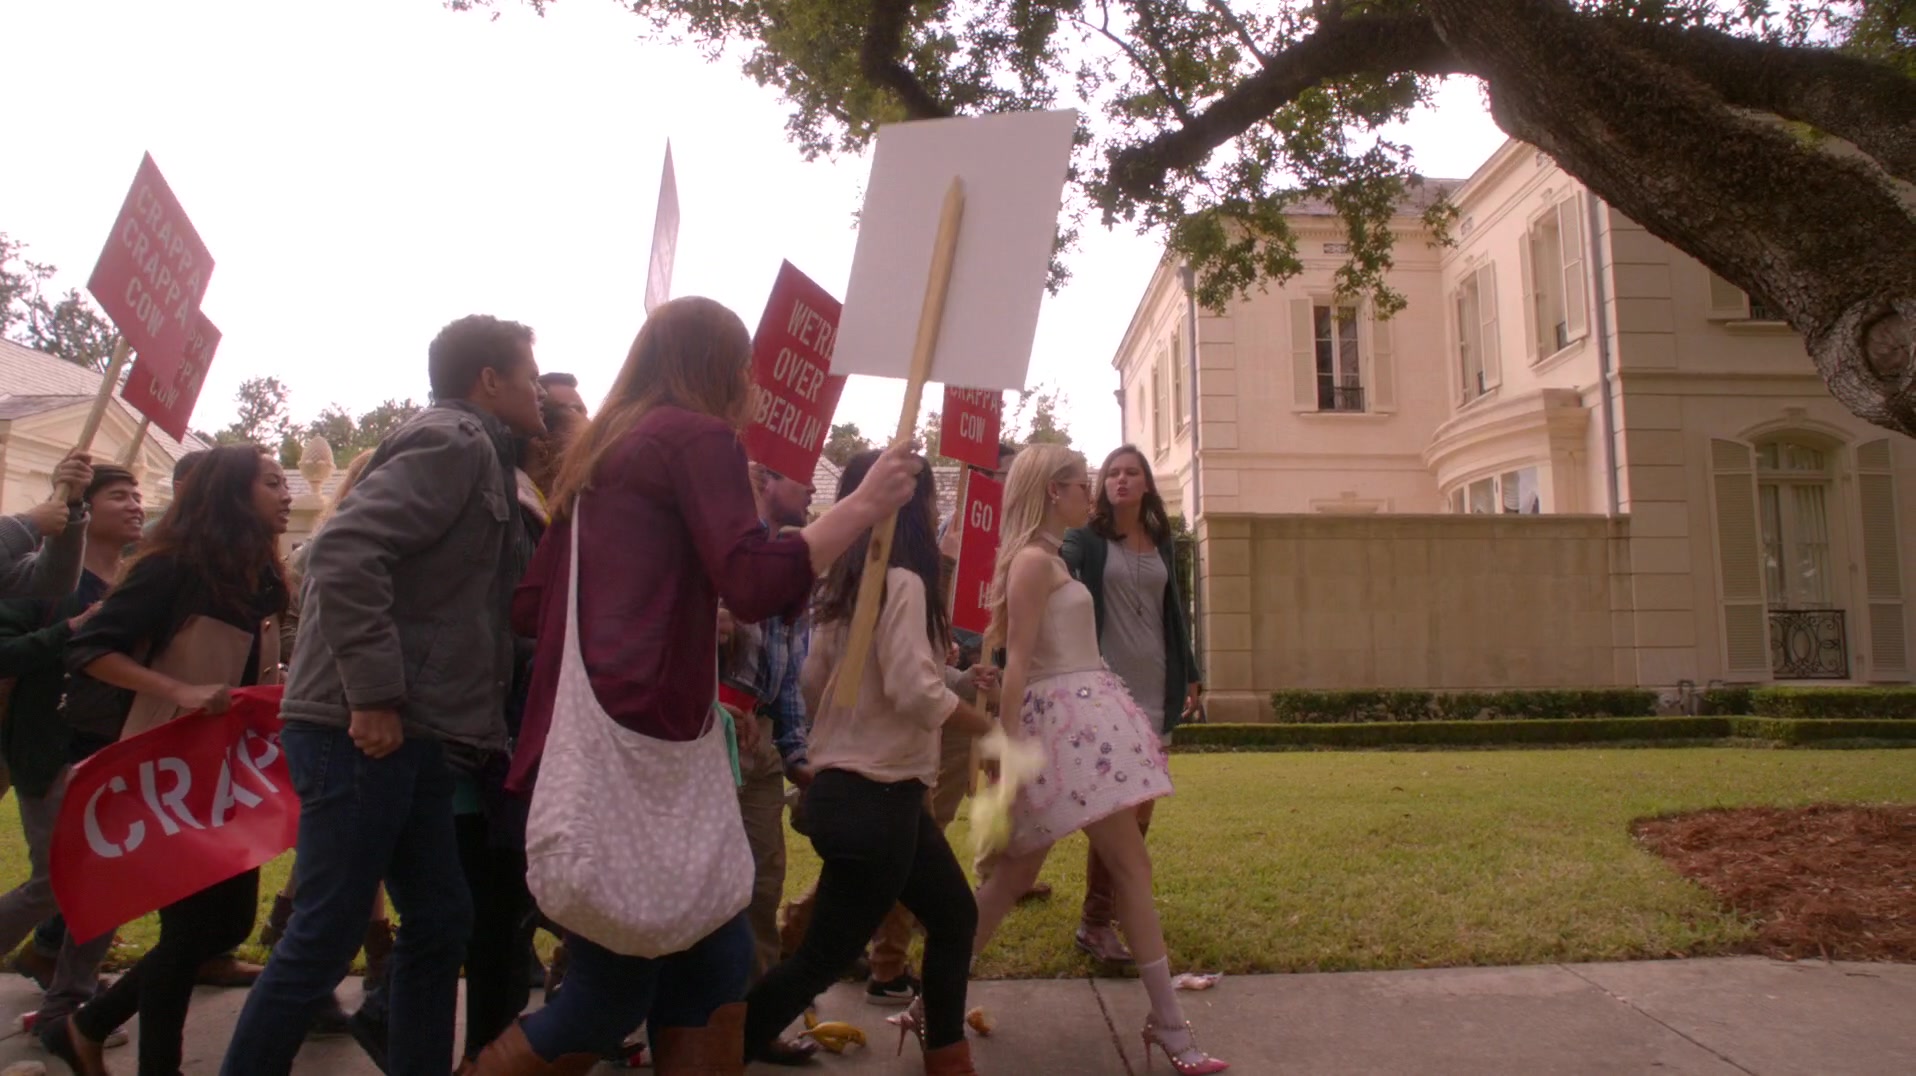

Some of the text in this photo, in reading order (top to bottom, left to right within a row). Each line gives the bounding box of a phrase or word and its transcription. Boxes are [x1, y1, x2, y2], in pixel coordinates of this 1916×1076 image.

[137, 184, 201, 297] CRAPPA
[122, 217, 189, 330] CRAPPA
[125, 276, 165, 338] COW
[773, 346, 825, 404] OVER
[960, 411, 986, 444] COW
[971, 500, 993, 532] GO
[84, 728, 280, 858] CRAP
